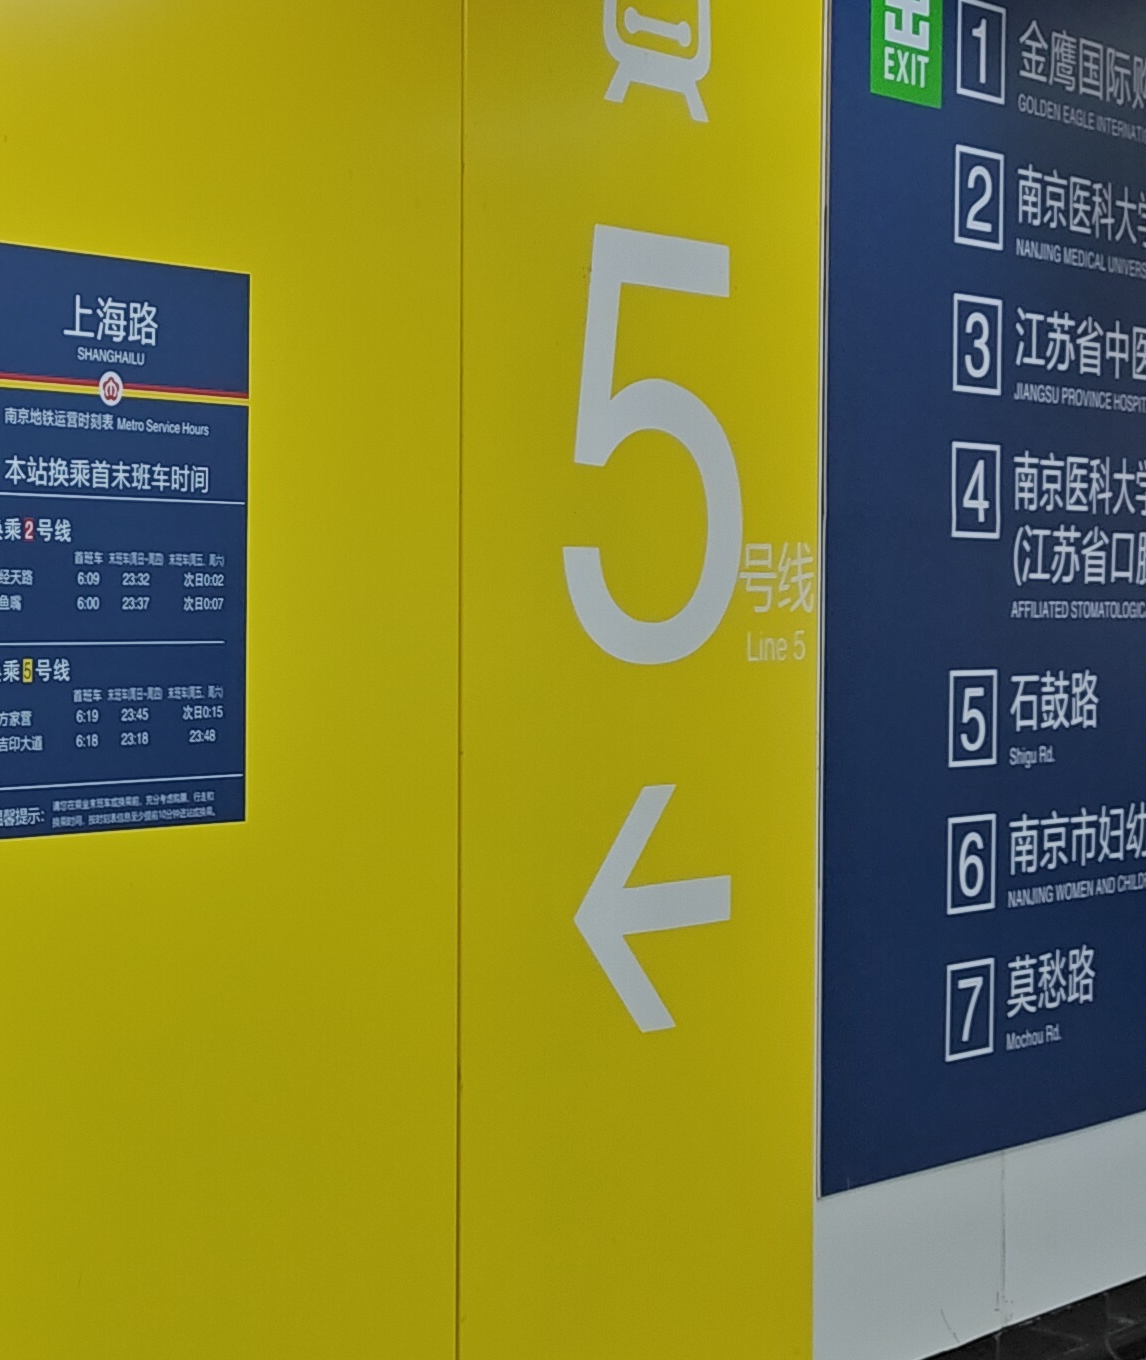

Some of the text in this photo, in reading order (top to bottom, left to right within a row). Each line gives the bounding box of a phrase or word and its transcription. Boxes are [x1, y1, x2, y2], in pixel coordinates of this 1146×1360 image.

[883, 45, 930, 88] EXIT
[971, 17, 987, 85] 1
[1018, 93, 1062, 121] GOLDEN
[1062, 105, 1096, 130] EAGLE
[966, 165, 993, 233] 2
[1016, 238, 1062, 263] NANJING
[1063, 246, 1107, 271] MEDICAL
[63, 294, 158, 346] 上海路
[77, 346, 145, 366] SHANGHAILU
[964, 311, 991, 378] 3
[1014, 382, 1060, 404] JIANGSU
[1061, 387, 1112, 410] PROVINCE
[4, 407, 209, 436] 南京地铁运营时刻表 Metro Service Hours
[562, 223, 815, 664] 5 号线
[4, 454, 209, 493] 本站换乘首末班车时间
[962, 459, 990, 523] 4
[77, 572, 100, 586] 6:09
[122, 572, 150, 586] 23:32
[183, 572, 225, 588] 次日0:02
[76, 597, 100, 610] 6:00
[121, 597, 150, 611] 23:37
[183, 596, 225, 612] 次日0:07
[1010, 600, 1146, 619] AFFILIATED STOMATOLOGIC
[747, 629, 806, 662] Line 5
[75, 709, 99, 723] 6:19
[121, 708, 149, 722] 23:45
[182, 705, 224, 721] 次日0:15
[960, 669, 1099, 752] 5 石鼓路
[75, 734, 99, 747] 6:18
[120, 732, 149, 746] 23:18
[189, 729, 216, 743] 23:48
[1039, 745, 1056, 763] Rd.
[958, 801, 1146, 898] 6 南京市妇幼
[1007, 884, 1054, 908] NANJING
[1055, 880, 1094, 901] WOMEN
[1095, 876, 1115, 895] AND
[957, 944, 1096, 1043] 7 莫愁路
[1006, 1023, 1062, 1051] Mochou Rd.
